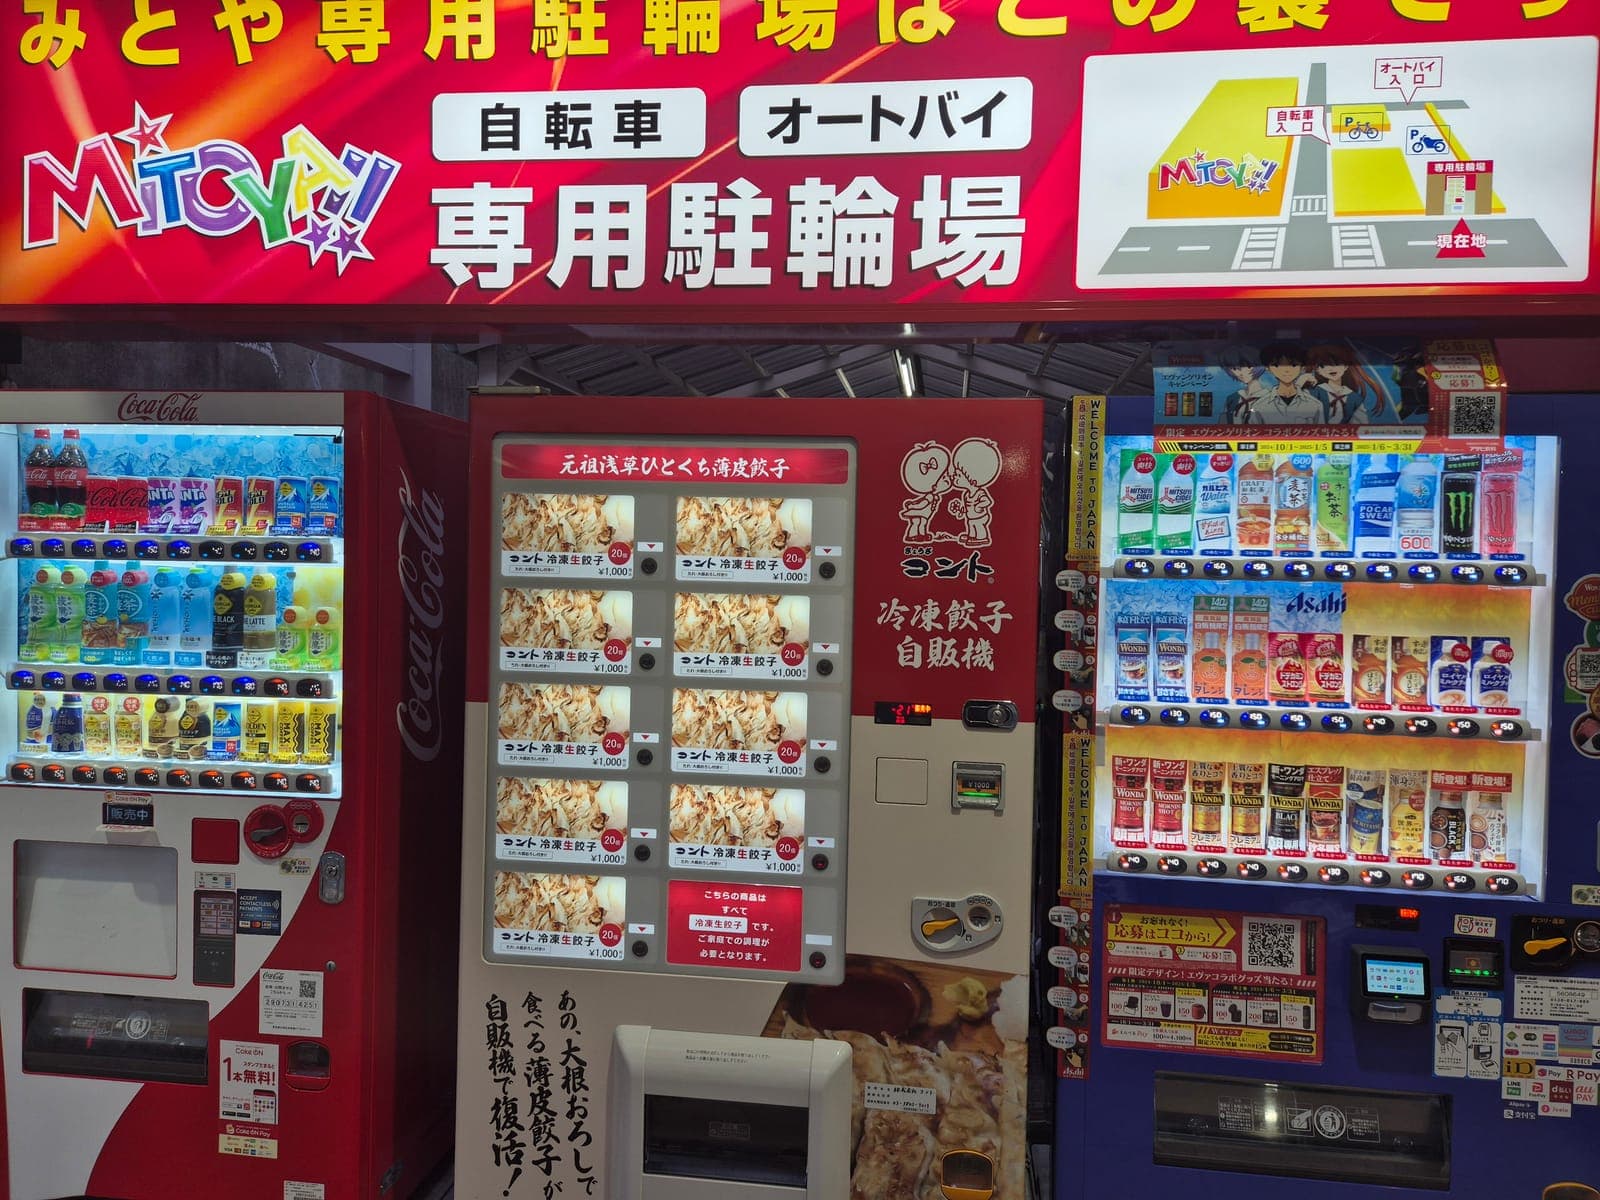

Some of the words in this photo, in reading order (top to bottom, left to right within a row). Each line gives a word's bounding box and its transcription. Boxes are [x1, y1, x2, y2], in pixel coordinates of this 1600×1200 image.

[1380, 61, 1436, 73] オートバイ
[1389, 74, 1425, 86] 入口
[769, 92, 1008, 144] オートバイ
[1277, 110, 1315, 122] 自転車
[1345, 117, 1353, 127] P
[479, 100, 663, 152] 自転車
[1276, 122, 1313, 133] 入口
[1411, 130, 1419, 139] P
[1434, 162, 1486, 173] 専用駐輪場
[429, 176, 1027, 292] 専用駐輪場
[1437, 234, 1487, 248] 現在地
[1168, 380, 1209, 388] キャンペーン
[117, 392, 203, 422] Coca-Cola
[1089, 400, 1101, 471] WELCOME
[1166, 428, 1185, 438] 限定
[1191, 428, 1264, 438] エヴァンゲリオン
[559, 453, 791, 480] 元祖浅草ひとくち薄皮餃子
[1292, 456, 1312, 465] 600
[1089, 478, 1097, 494] TO
[1201, 491, 1229, 501] Water
[1288, 479, 1301, 508] 麦茶
[1087, 502, 1097, 550] JAPAN
[1400, 537, 1431, 550] 600
[509, 553, 543, 563] コント
[547, 554, 604, 565] 冷凍生餃子
[682, 557, 716, 568] コント
[720, 559, 779, 570] 冷凍生餃子
[598, 567, 628, 576] ¥1,000
[901, 551, 994, 583] コント
[1459, 567, 1475, 575] 230
[772, 571, 803, 582] ¥1,000
[1286, 592, 1347, 614] Asahi
[397, 465, 446, 762] Coca-Cola
[876, 597, 1013, 634] 冷凍餃子
[896, 635, 995, 671] 自販機
[1119, 643, 1148, 653] WONDA
[1159, 643, 1186, 653] WONDA
[505, 650, 540, 660] コント
[543, 650, 600, 662] 冷凍生餃子
[681, 655, 715, 665] コント
[718, 655, 777, 668] 冷凍生餃子
[594, 663, 624, 673] ¥1,000
[771, 667, 802, 678] ¥1,000
[1458, 721, 1471, 729] 150
[504, 743, 538, 753] コント
[541, 743, 598, 756] 冷凍生餃子
[592, 756, 622, 767] ¥1,000
[677, 750, 711, 761] コント
[715, 751, 774, 764] 冷凍生餃子
[767, 764, 798, 776] ¥1,000
[1080, 738, 1091, 809] WELCOME
[1432, 772, 1467, 785] 新登場!
[1472, 775, 1507, 787] 新登場!
[1115, 787, 1145, 798] WONDA
[1154, 791, 1183, 801] WONDA
[1194, 793, 1222, 803] WONDA
[1232, 795, 1262, 805] WONDA
[1272, 796, 1302, 807] WONDA
[1310, 797, 1341, 809] WONDA
[111, 808, 149, 821] 販売中
[1079, 816, 1088, 831] TO
[503, 838, 536, 849] コント
[540, 839, 597, 852] 冷凍生餃子
[591, 853, 621, 864] ¥1,000
[675, 846, 709, 857] コント
[713, 847, 772, 861] 冷凍生餃子
[765, 861, 796, 872] ¥1,000
[1078, 838, 1088, 887] JAPAN
[704, 890, 767, 902] こちらの商品は
[721, 905, 748, 915] すべて
[694, 918, 742, 930] 冷凍生餃子
[752, 922, 774, 932] です。
[1140, 916, 1188, 927] お忘れなく!
[1114, 924, 1211, 943] 応募はココから!
[1476, 926, 1490, 935] OK
[501, 932, 534, 943] コント
[537, 933, 595, 946] 冷凍生餃子
[698, 934, 770, 947] ご家庭での調理が
[589, 948, 619, 959] ¥1,000
[700, 949, 767, 962] 必要となります。
[1128, 967, 1185, 979] 限定デザイン!
[1186, 970, 1294, 986] エヴァコラボグッズ当たる!
[222, 1057, 276, 1086] 1本無料!
[1505, 1060, 1534, 1076] iD
[485, 993, 526, 1197] 自販機で復活!
[521, 991, 563, 1200] 食べる薄皮餃子が
[558, 990, 599, 1196] あの、大根おろしで
